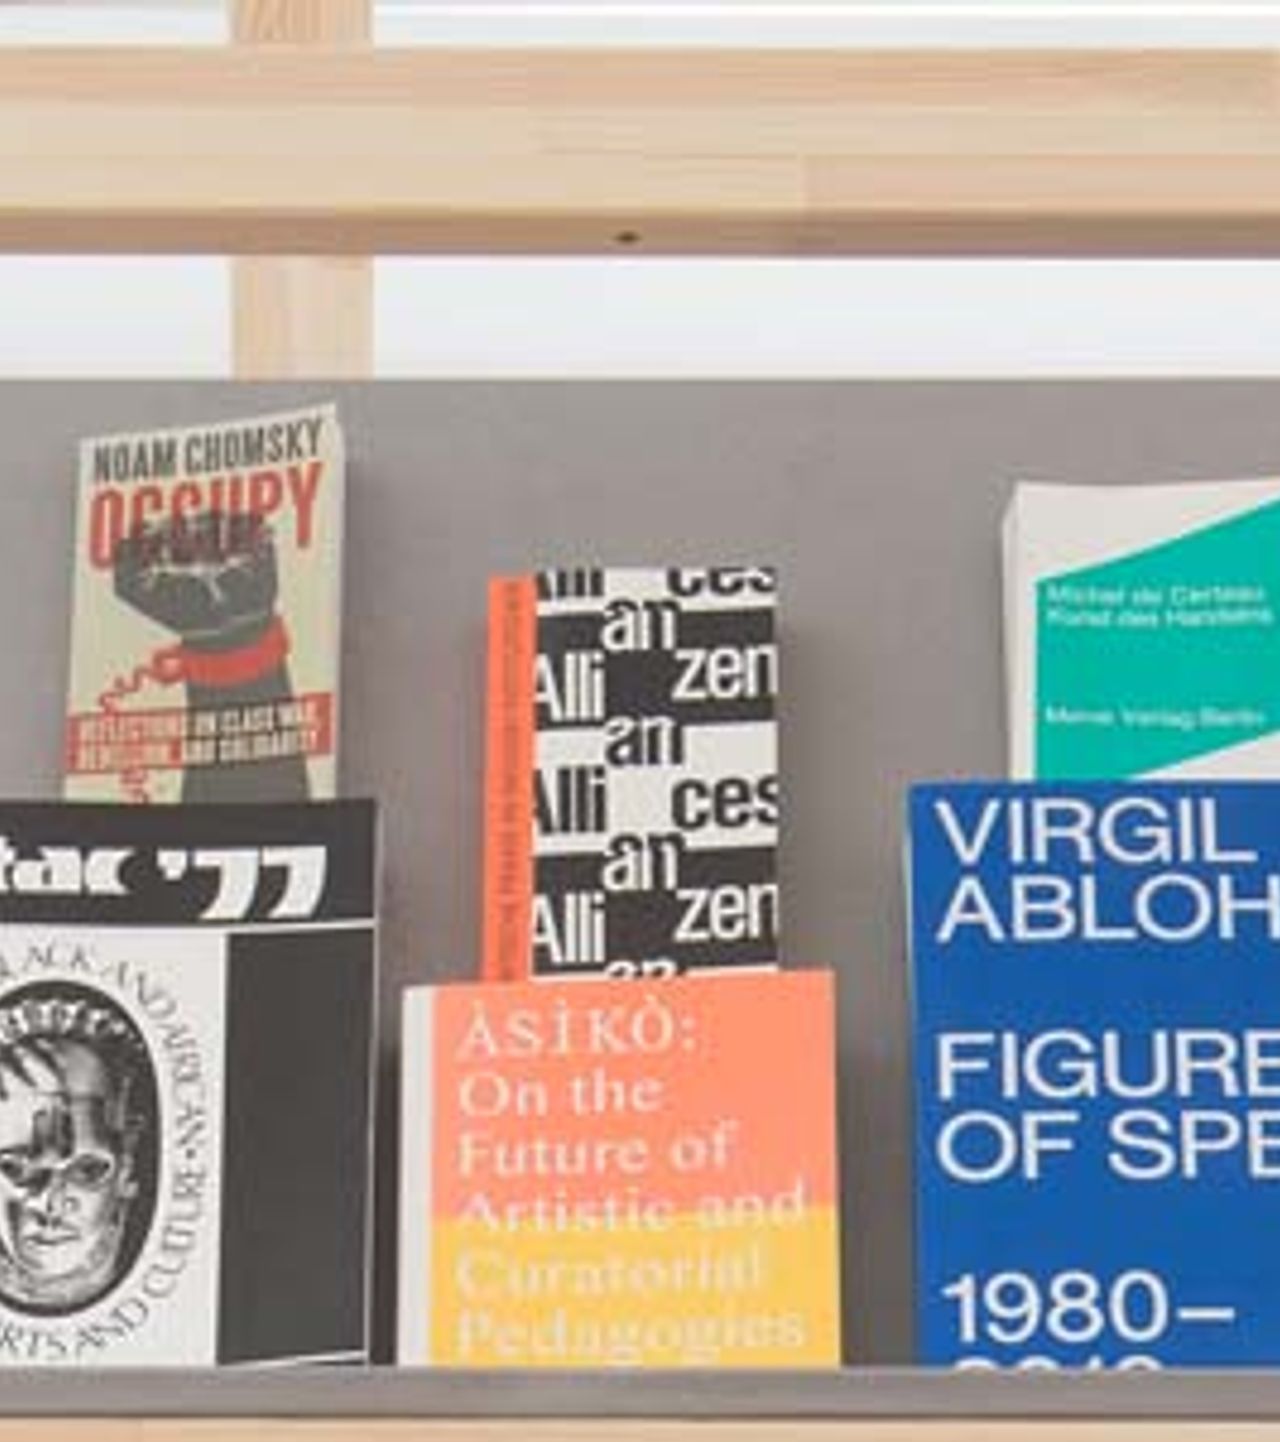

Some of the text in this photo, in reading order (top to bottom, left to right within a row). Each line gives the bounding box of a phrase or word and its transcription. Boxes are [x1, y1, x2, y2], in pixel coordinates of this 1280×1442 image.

[94, 418, 323, 482] NOAM CHOMSKY
[89, 461, 325, 570] OCCUPY
[936, 796, 1258, 865] VIRGIL
[100, 958, 179, 1024] AND
[458, 1066, 664, 1117] On the
[458, 1119, 739, 1178] Future of
[934, 1109, 1080, 1181] OF
[457, 1174, 808, 1234] Artistic and
[73, 1296, 152, 1357] AND
[140, 1162, 209, 1301] CULTURE
[456, 1240, 762, 1297] Curatorial
